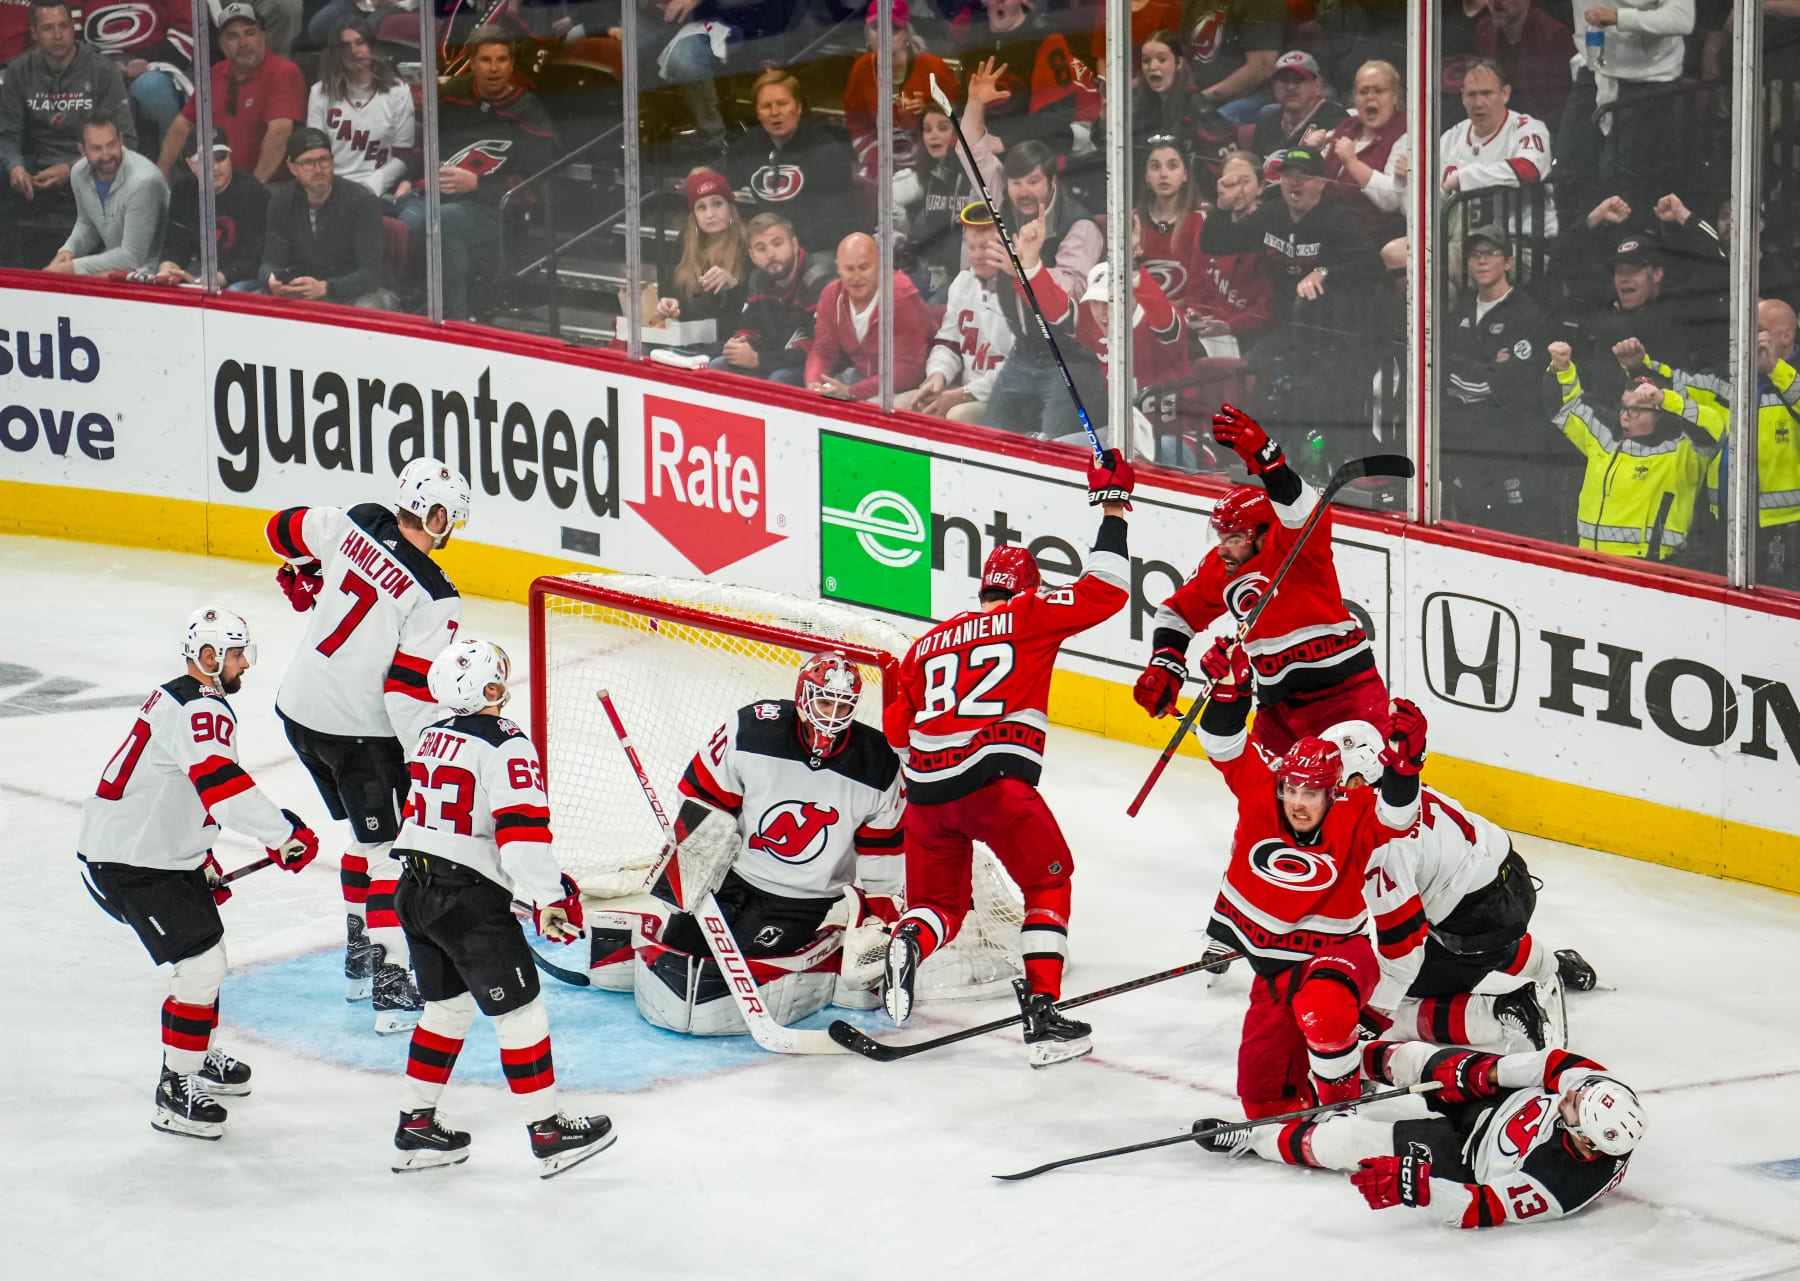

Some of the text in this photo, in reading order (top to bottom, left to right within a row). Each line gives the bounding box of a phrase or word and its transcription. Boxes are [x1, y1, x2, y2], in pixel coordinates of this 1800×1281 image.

[26, 98, 94, 111] PLAYOFFS
[326, 108, 389, 170] CANES
[1518, 133, 1545, 153] 20
[957, 308, 1005, 371] CANE
[213, 358, 760, 520] guaranteed Rate
[339, 529, 415, 600] HAMILTON
[992, 572, 1009, 585] 82
[315, 568, 379, 659] 7
[913, 611, 1014, 664] KOTKANIEMI
[914, 641, 1016, 726] 82
[190, 711, 234, 747] 90
[416, 731, 467, 762] BRATT
[507, 757, 546, 793] 63
[1297, 756, 1311, 768] 71
[1364, 865, 1397, 898] 71
[703, 916, 764, 1015] BAUER
[1400, 1155, 1414, 1201] CCM
[1506, 1182, 1549, 1220] 13
